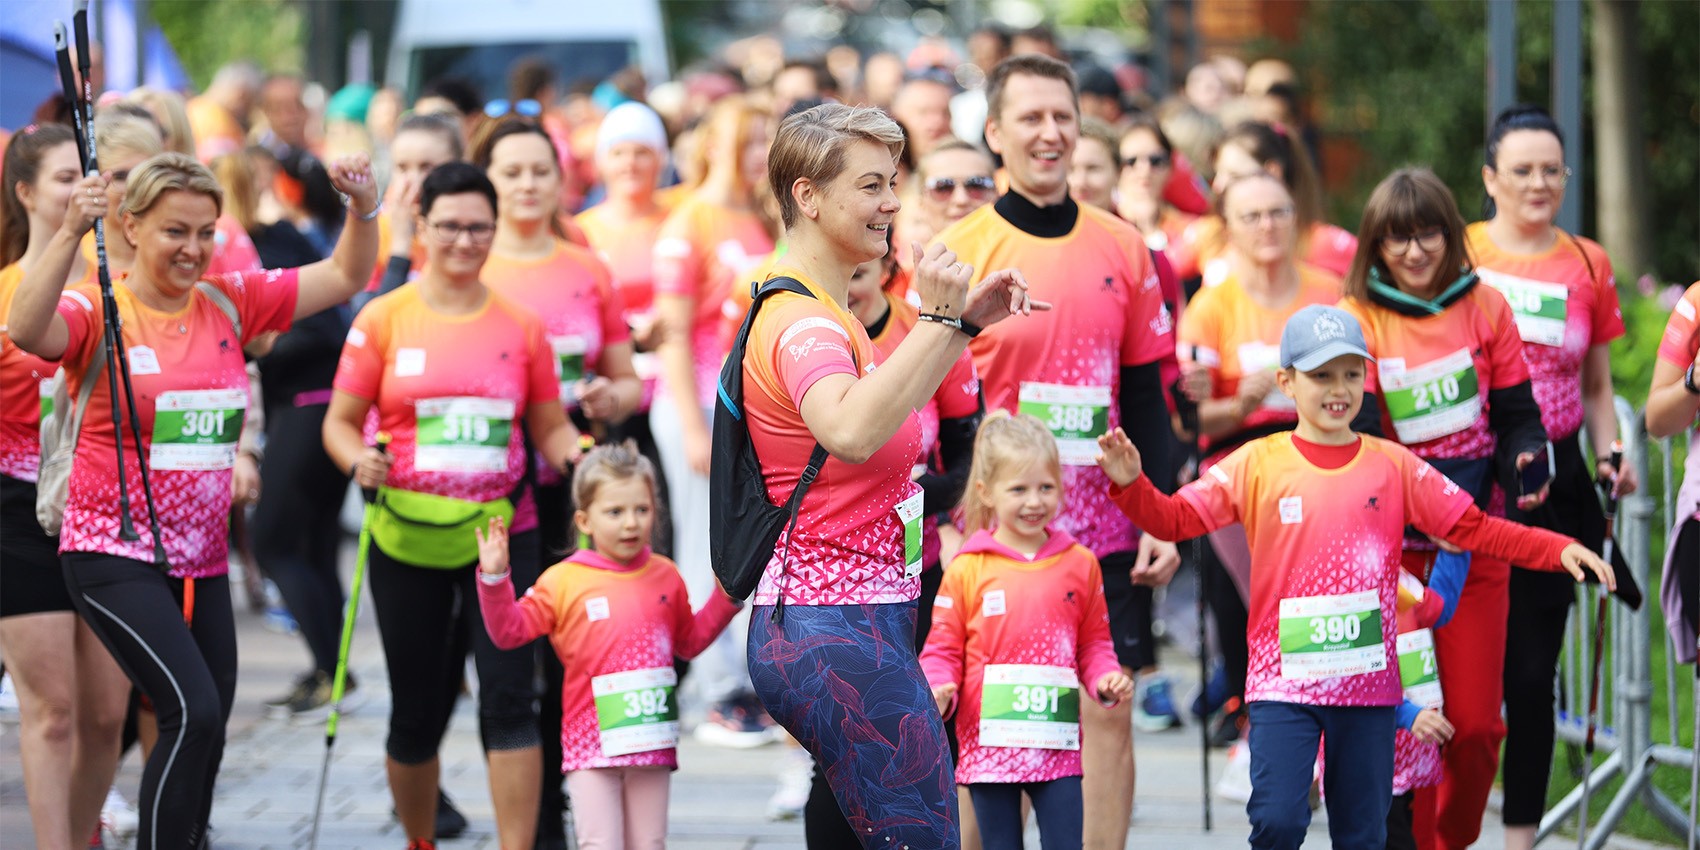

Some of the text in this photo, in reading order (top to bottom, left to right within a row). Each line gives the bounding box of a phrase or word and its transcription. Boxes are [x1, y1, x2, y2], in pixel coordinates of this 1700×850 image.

[1412, 376, 1459, 411] 210
[181, 409, 224, 436] 301
[442, 414, 490, 442] 319
[1047, 405, 1094, 432] 388
[1309, 614, 1360, 644] 390
[623, 688, 669, 718] 392
[1012, 685, 1059, 713] 391
